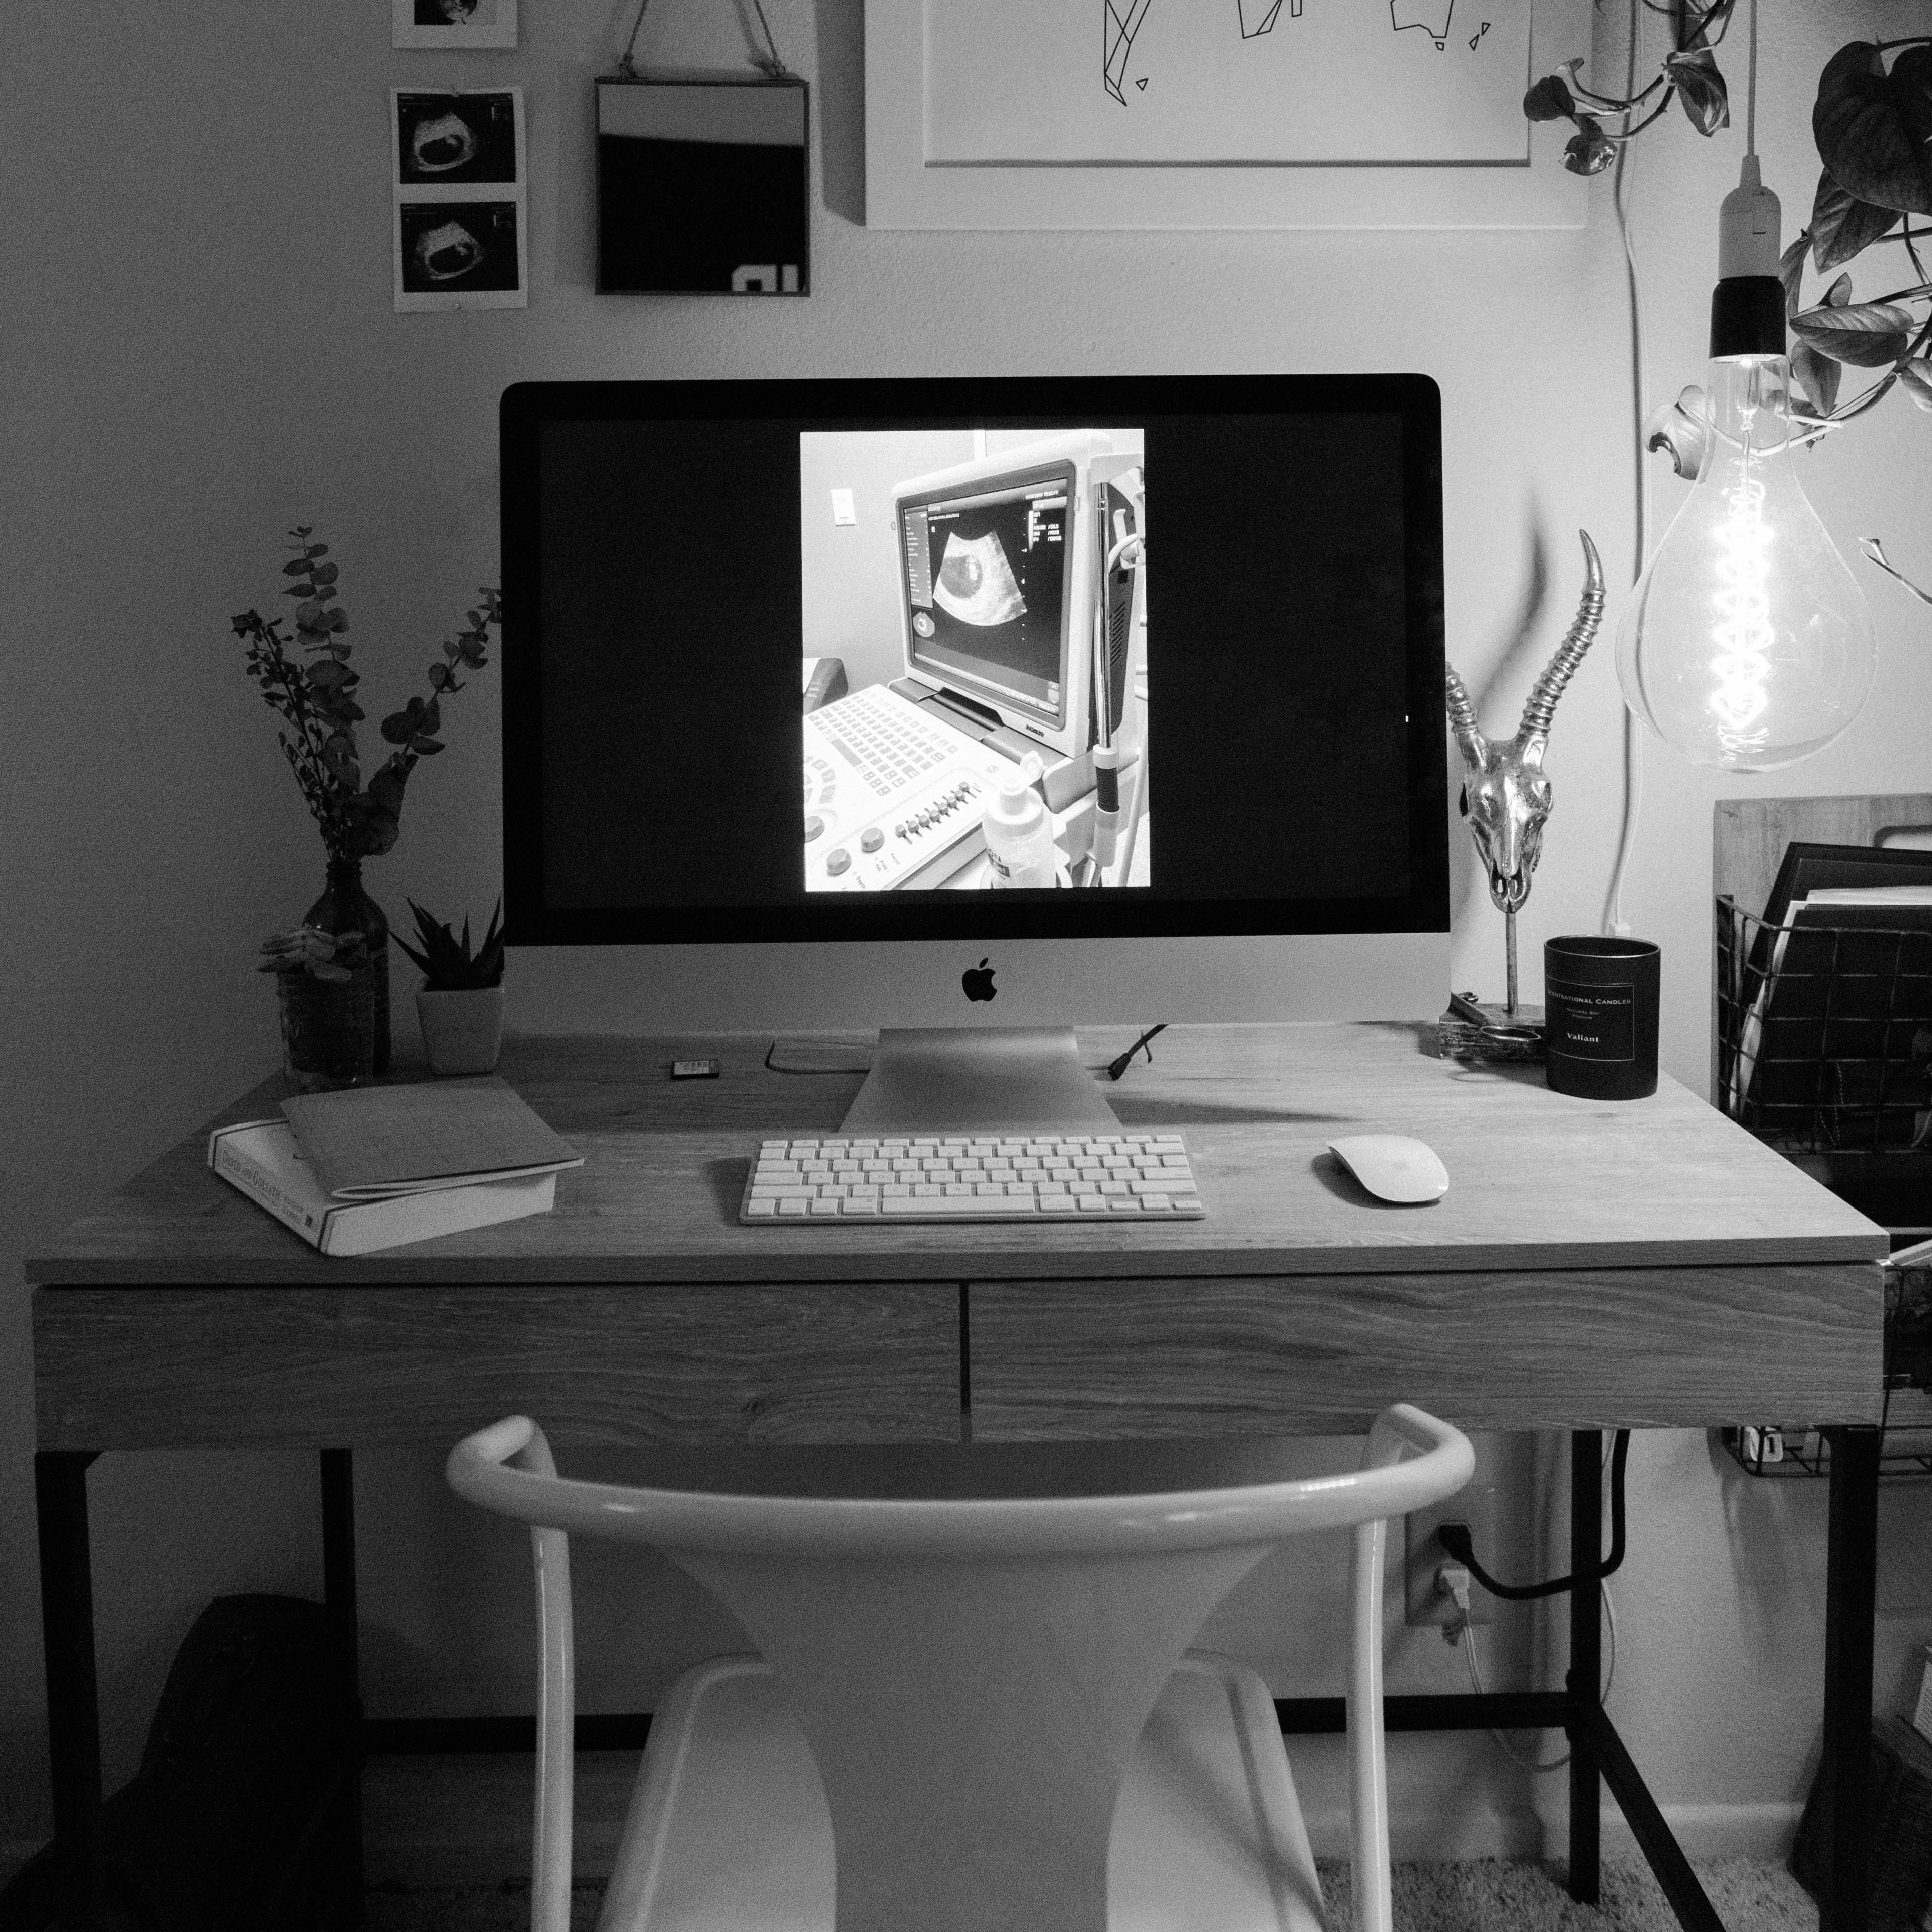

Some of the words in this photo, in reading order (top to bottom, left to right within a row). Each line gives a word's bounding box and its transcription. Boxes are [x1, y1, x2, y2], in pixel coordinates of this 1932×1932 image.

[890, 853, 900, 865] Focus
[856, 875, 866, 889] Depth
[1567, 1032, 1599, 1043] Valiant
